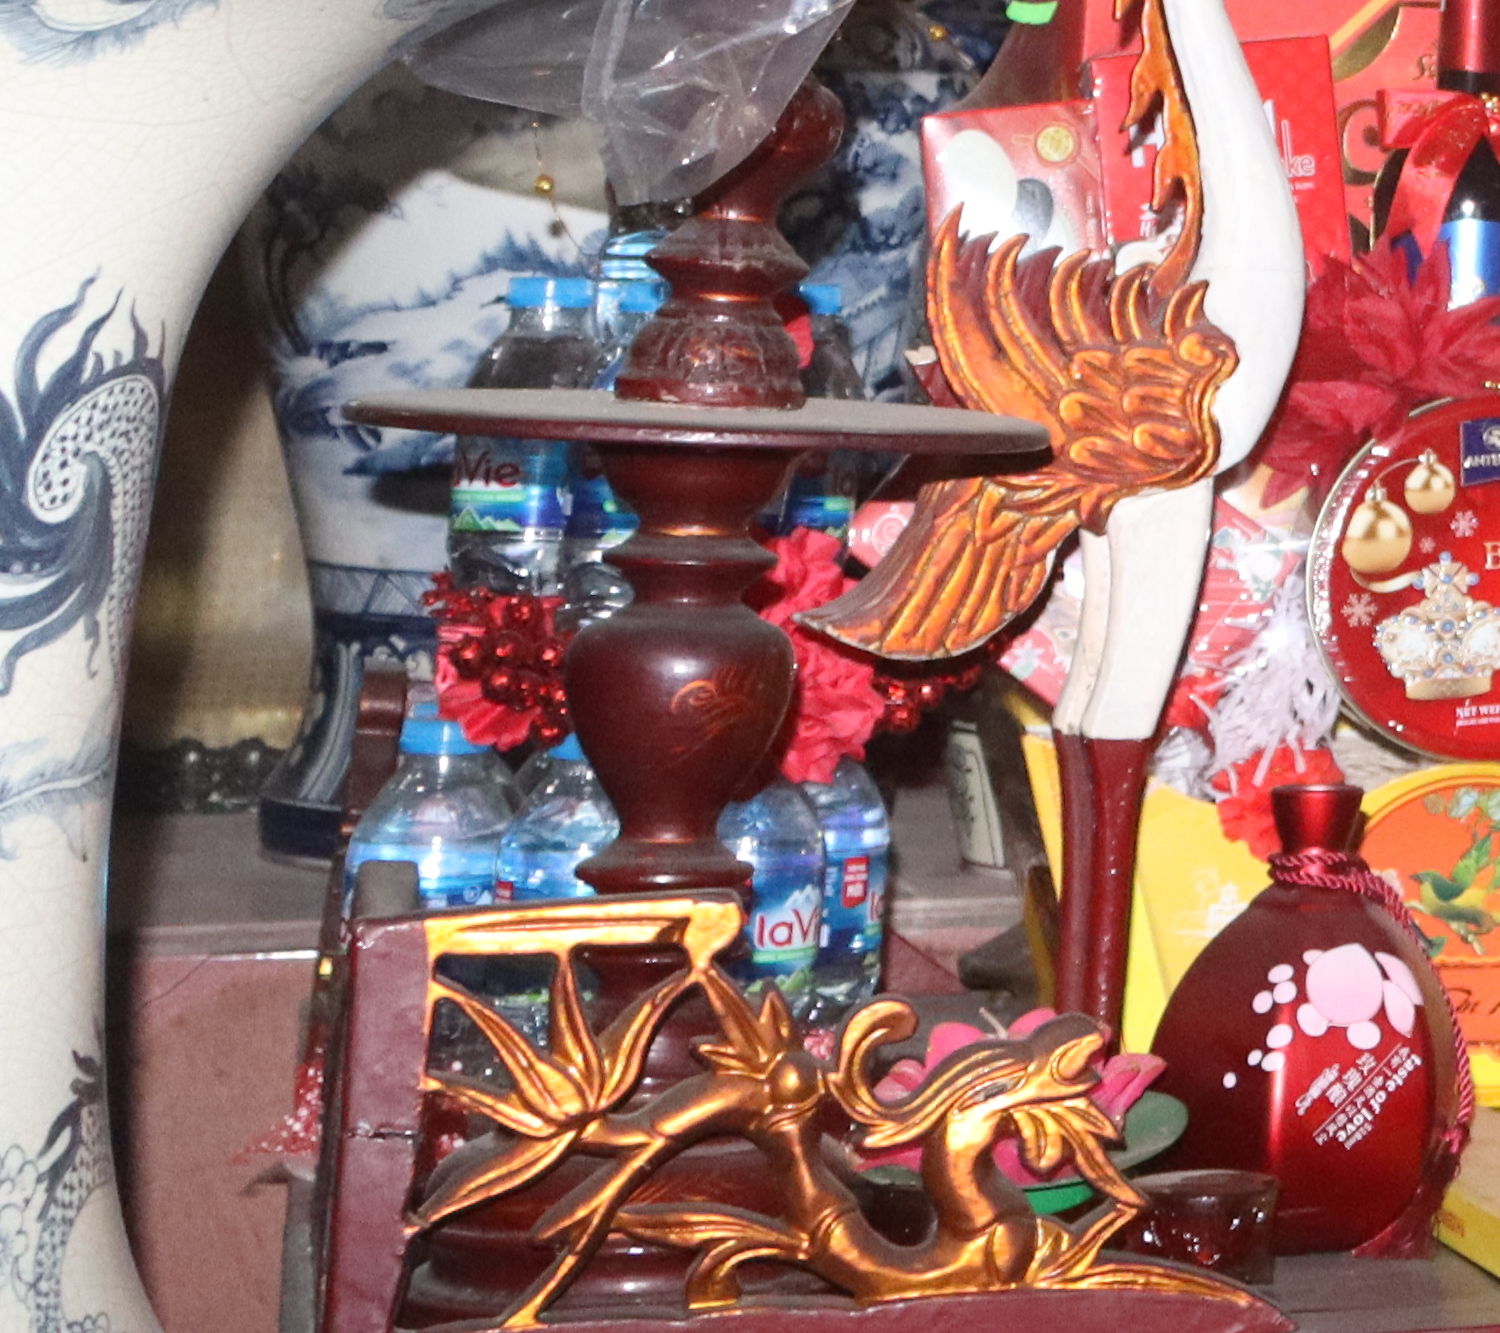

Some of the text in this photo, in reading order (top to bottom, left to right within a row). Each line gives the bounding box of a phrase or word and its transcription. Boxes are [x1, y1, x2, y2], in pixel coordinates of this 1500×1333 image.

[1387, 1052, 1423, 1093] taste
[1368, 1090, 1388, 1116] of
[1335, 1105, 1376, 1143] love
